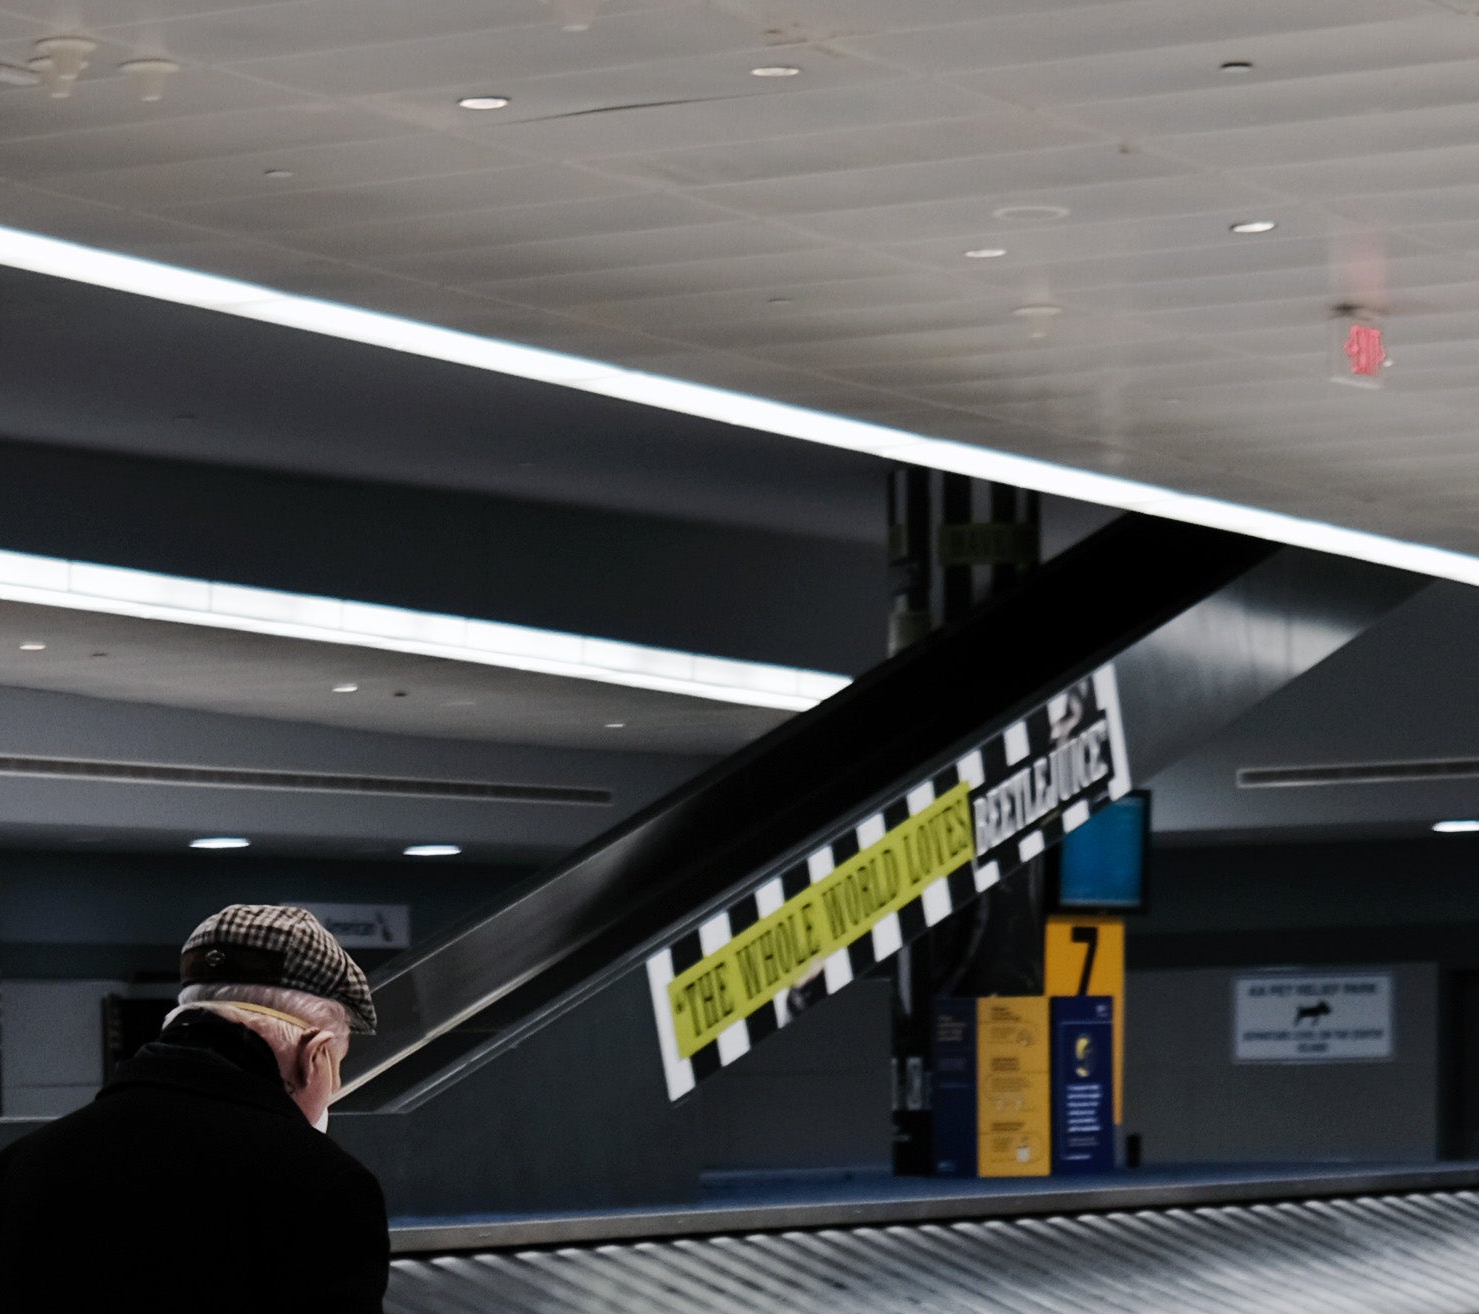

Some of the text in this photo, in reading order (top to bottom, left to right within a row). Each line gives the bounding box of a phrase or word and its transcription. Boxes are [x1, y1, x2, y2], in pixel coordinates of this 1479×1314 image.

[735, 900, 825, 1001] WHOLE
[821, 849, 899, 941] WORLD
[899, 799, 972, 890] LOVES
[1071, 926, 1098, 996] 7
